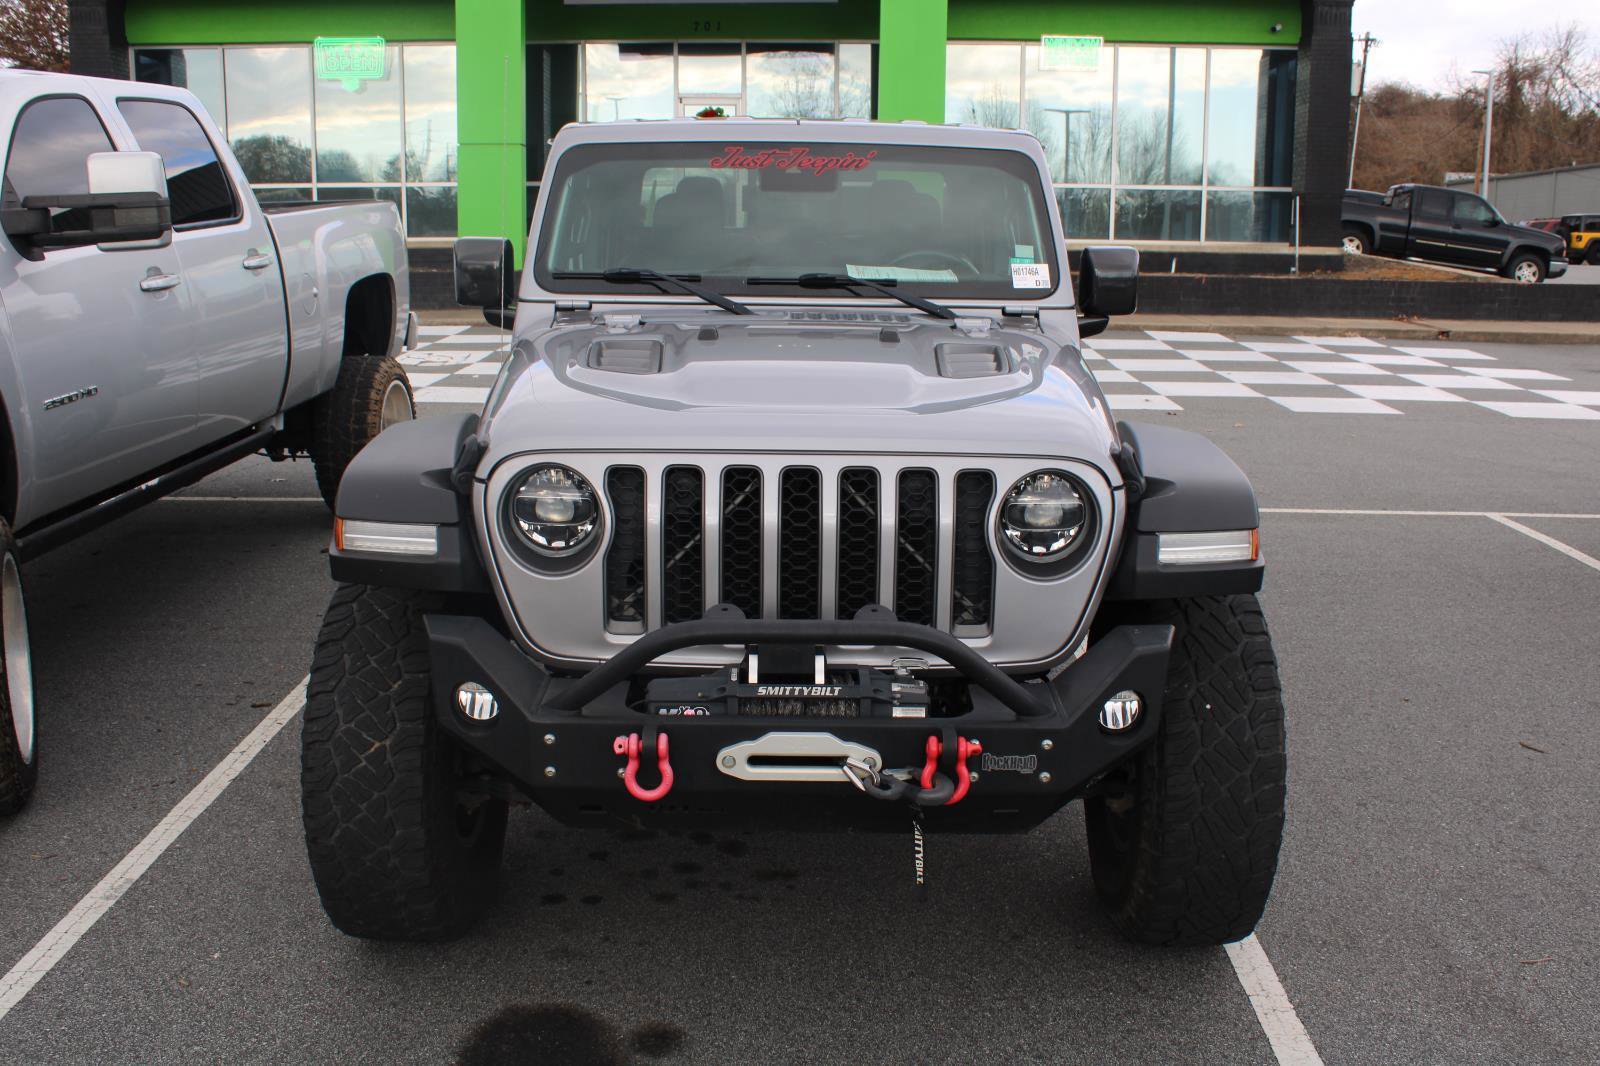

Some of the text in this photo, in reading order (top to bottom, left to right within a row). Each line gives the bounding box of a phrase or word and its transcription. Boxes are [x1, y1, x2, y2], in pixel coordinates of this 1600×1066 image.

[326, 55, 377, 71] OPEN
[710, 147, 776, 170] Just
[757, 686, 842, 696] SMITTYBILT
